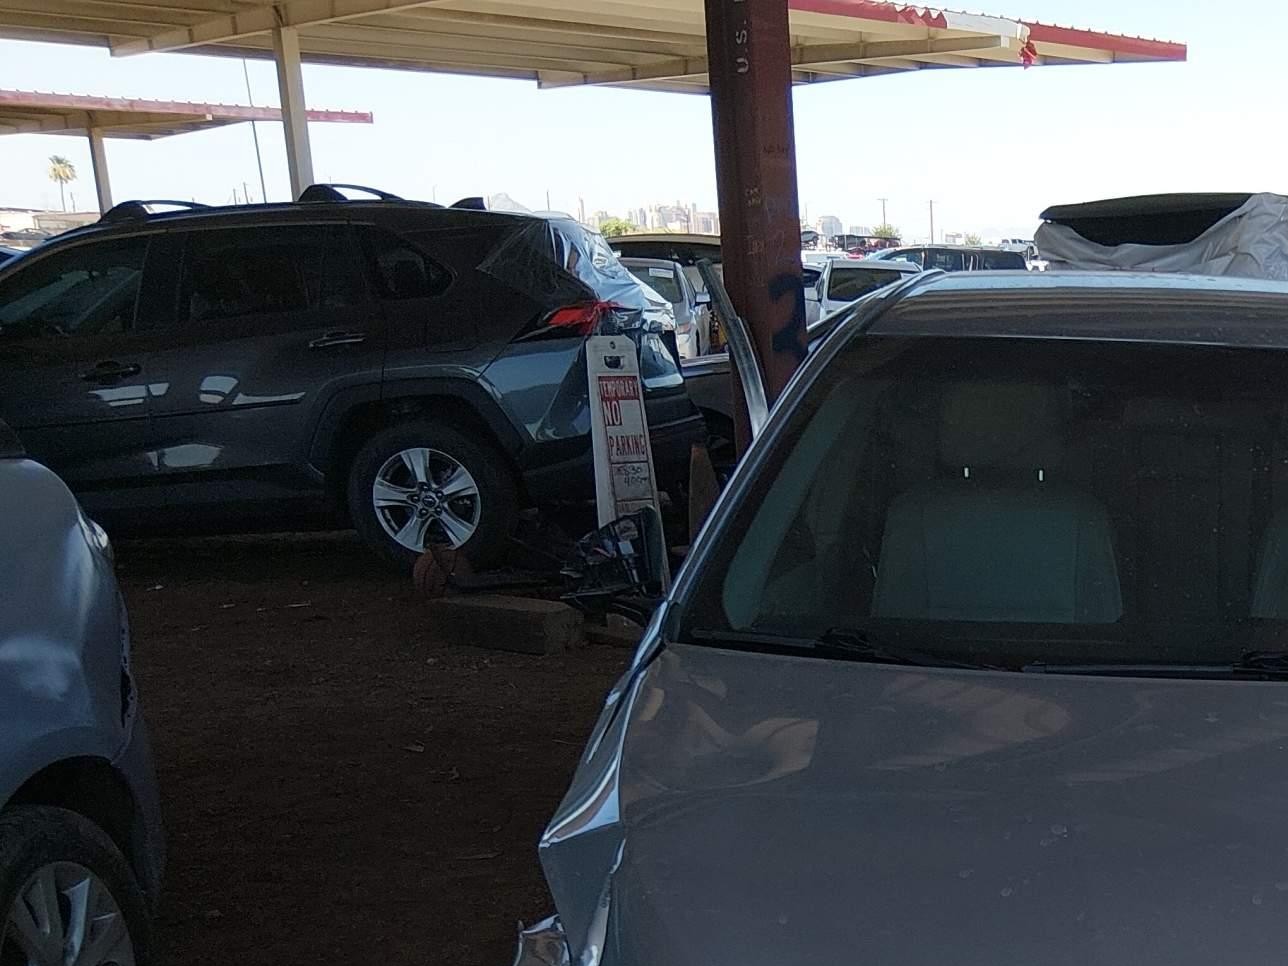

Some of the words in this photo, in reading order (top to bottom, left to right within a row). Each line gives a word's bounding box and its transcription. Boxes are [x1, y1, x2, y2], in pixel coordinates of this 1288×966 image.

[600, 381, 640, 400] TEMPORARY
[603, 401, 621, 425] NO
[609, 434, 646, 457] PARKING
